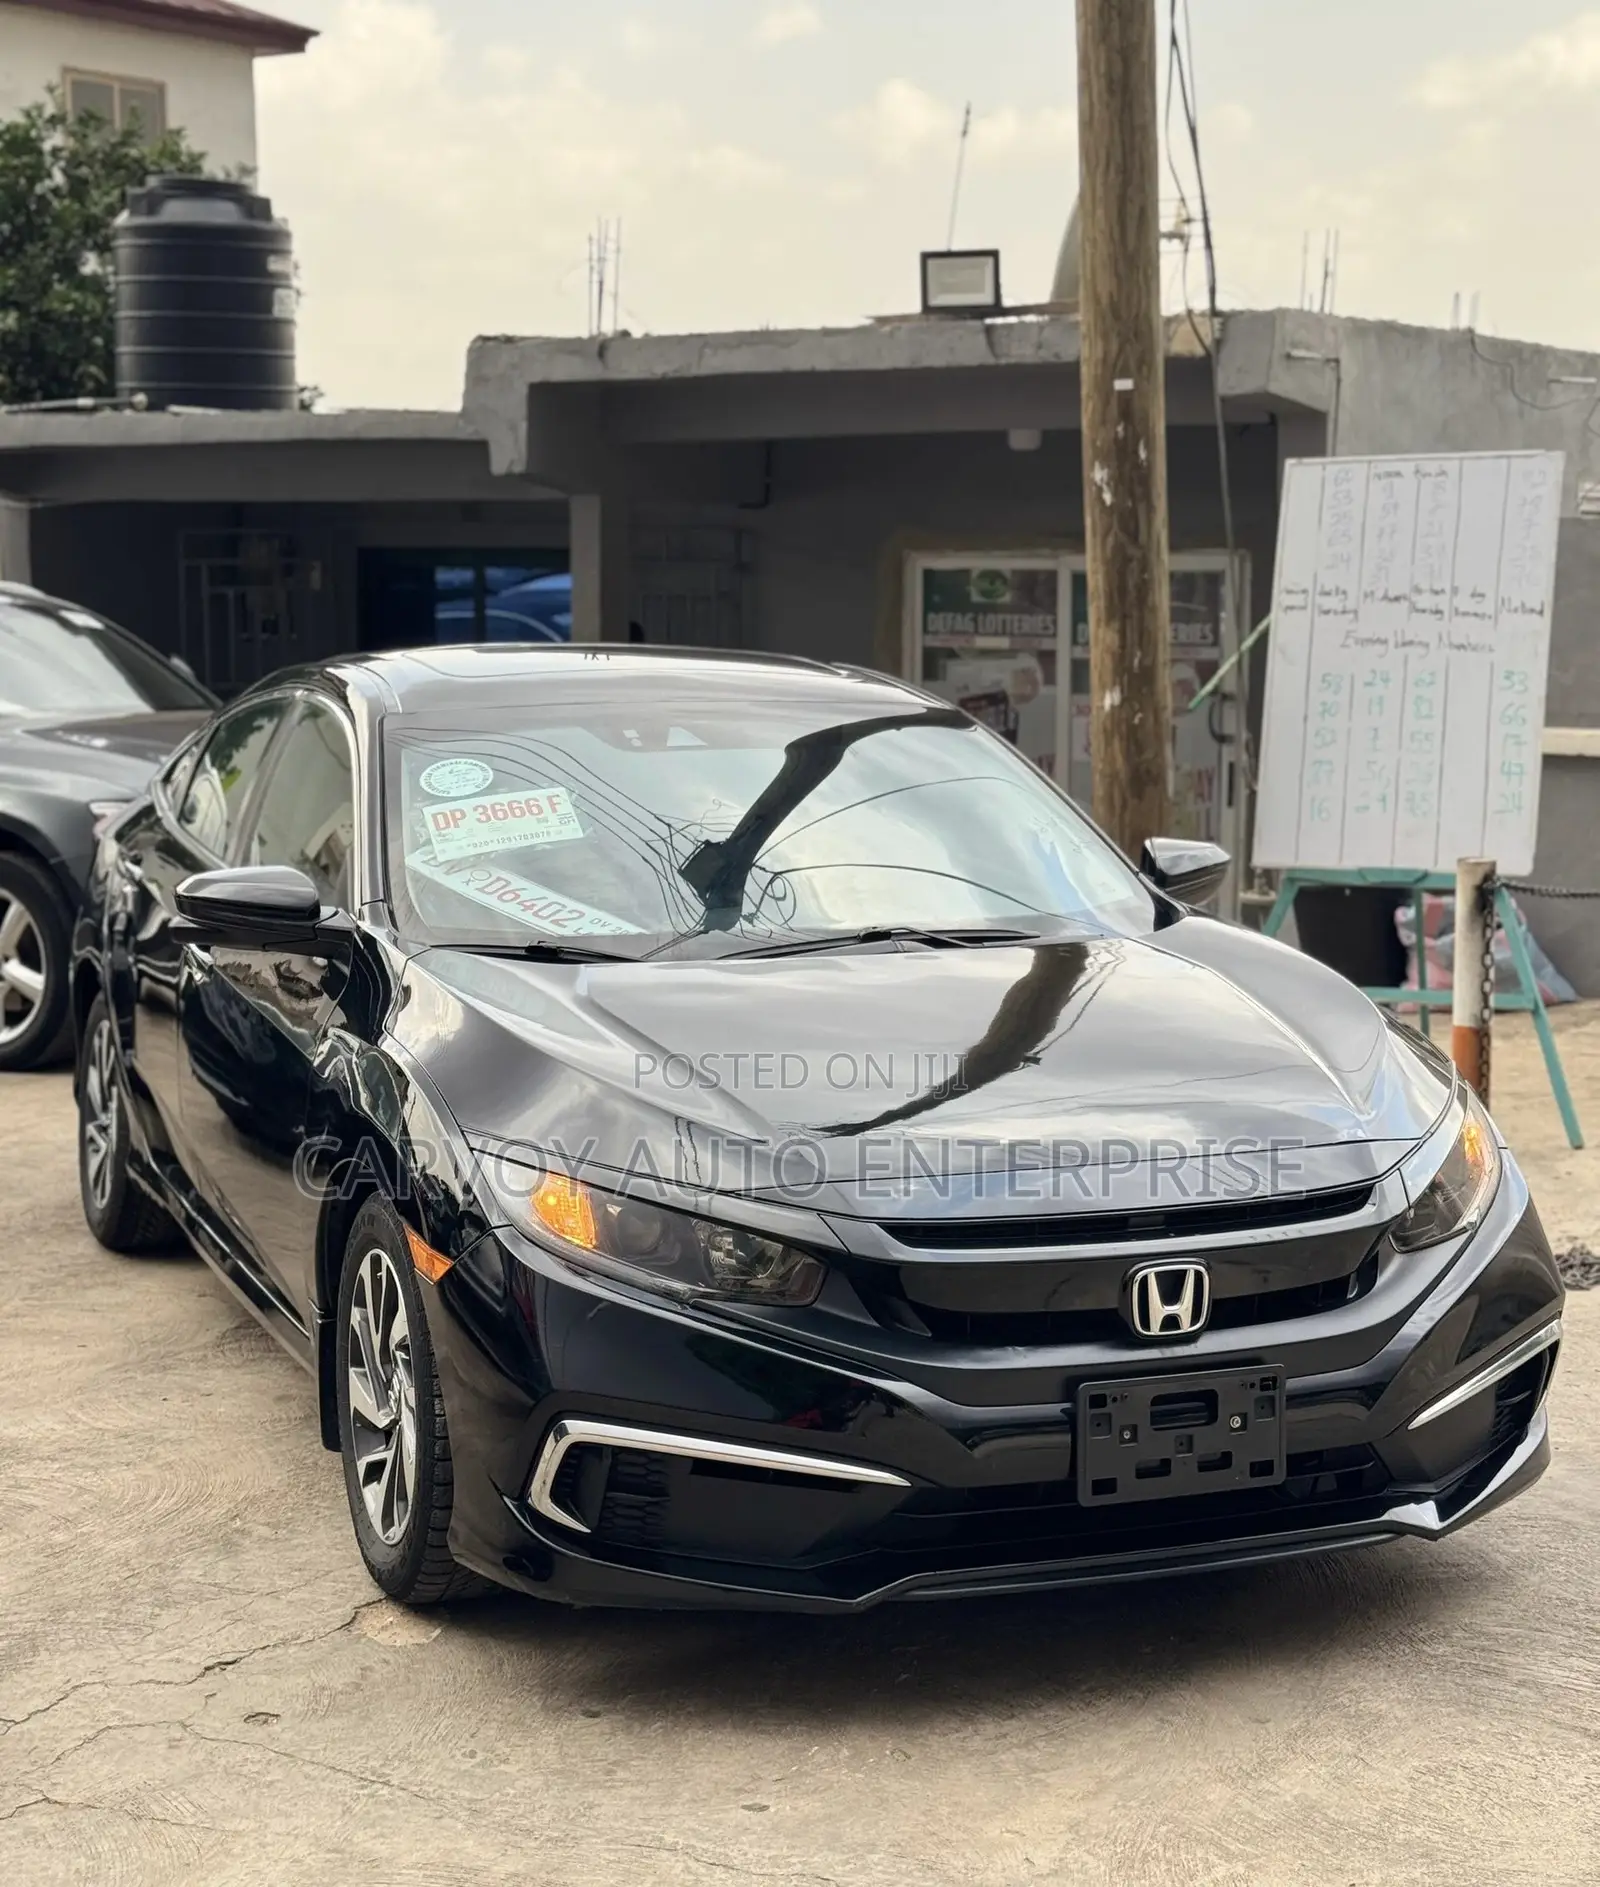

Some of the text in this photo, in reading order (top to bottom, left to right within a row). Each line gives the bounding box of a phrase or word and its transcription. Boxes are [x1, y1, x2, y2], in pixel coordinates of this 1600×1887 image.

[977, 612, 1056, 636] LOTTERIES
[430, 794, 562, 832] DP 3666 F
